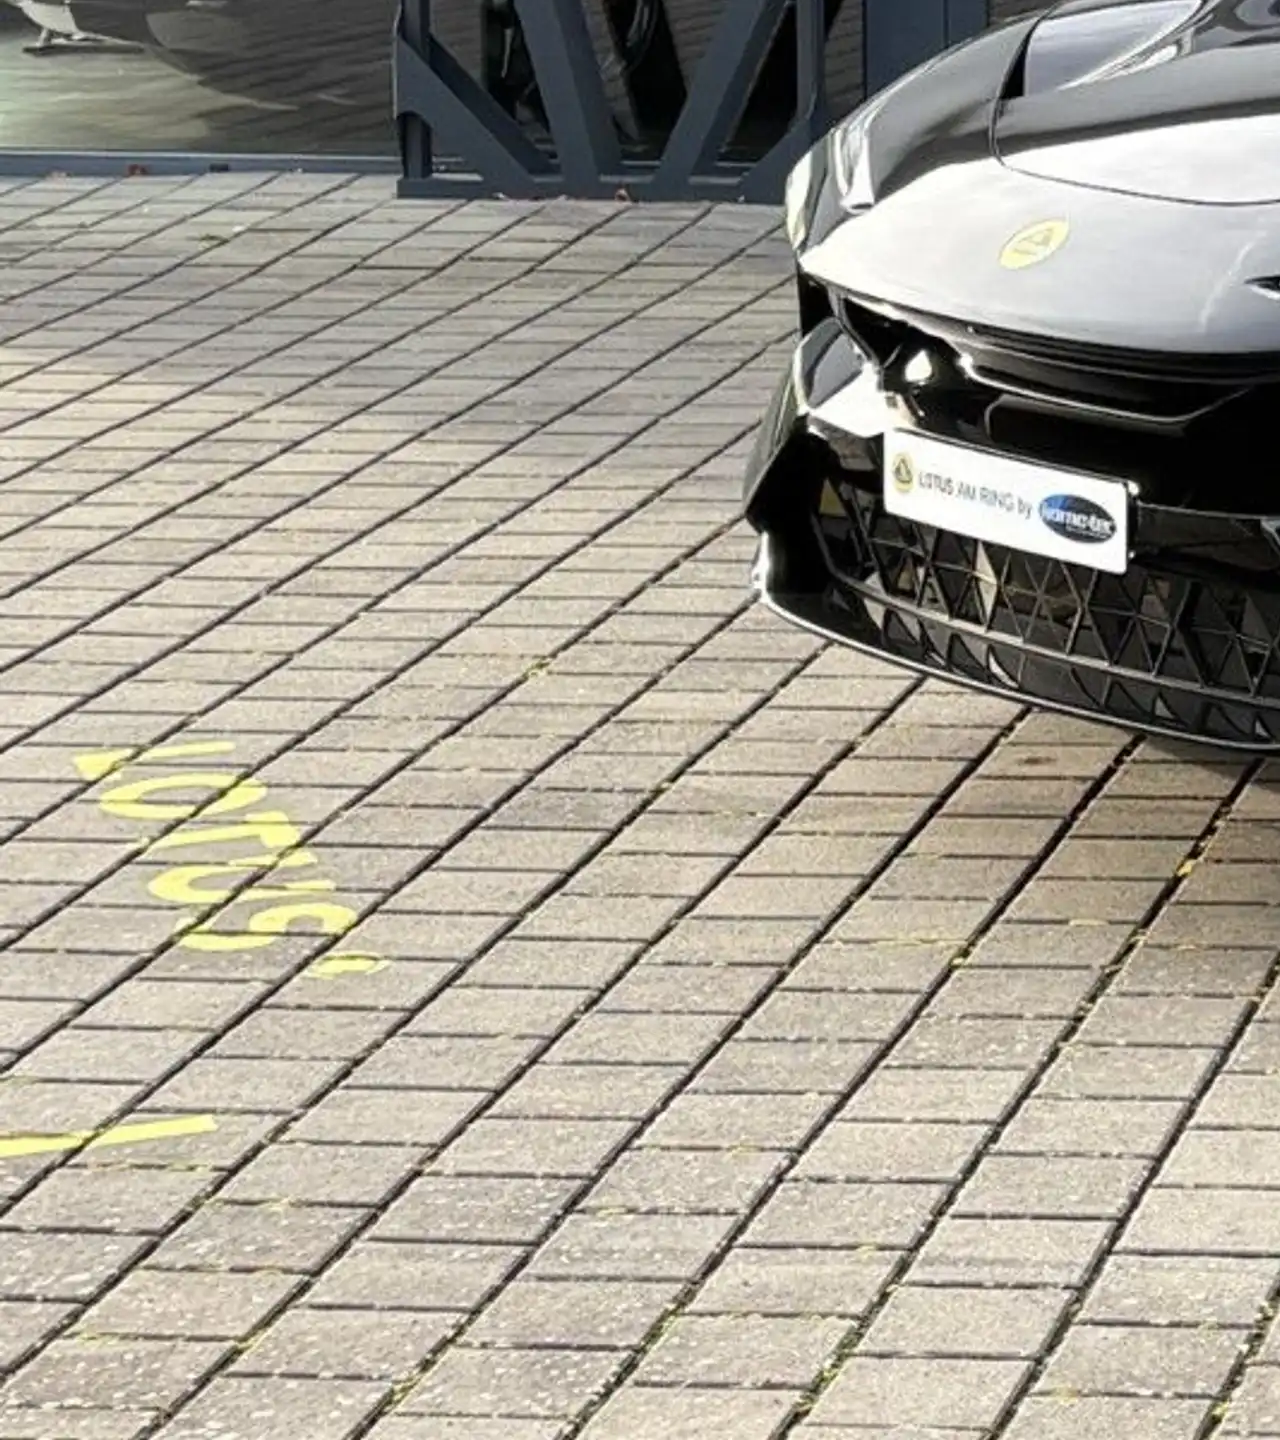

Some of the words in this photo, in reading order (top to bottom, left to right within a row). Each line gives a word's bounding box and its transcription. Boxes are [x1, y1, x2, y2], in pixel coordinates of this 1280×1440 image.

[918, 471, 955, 496] LOTUS
[956, 481, 977, 501] AM
[979, 486, 1015, 512] RING
[1017, 495, 1034, 520] by
